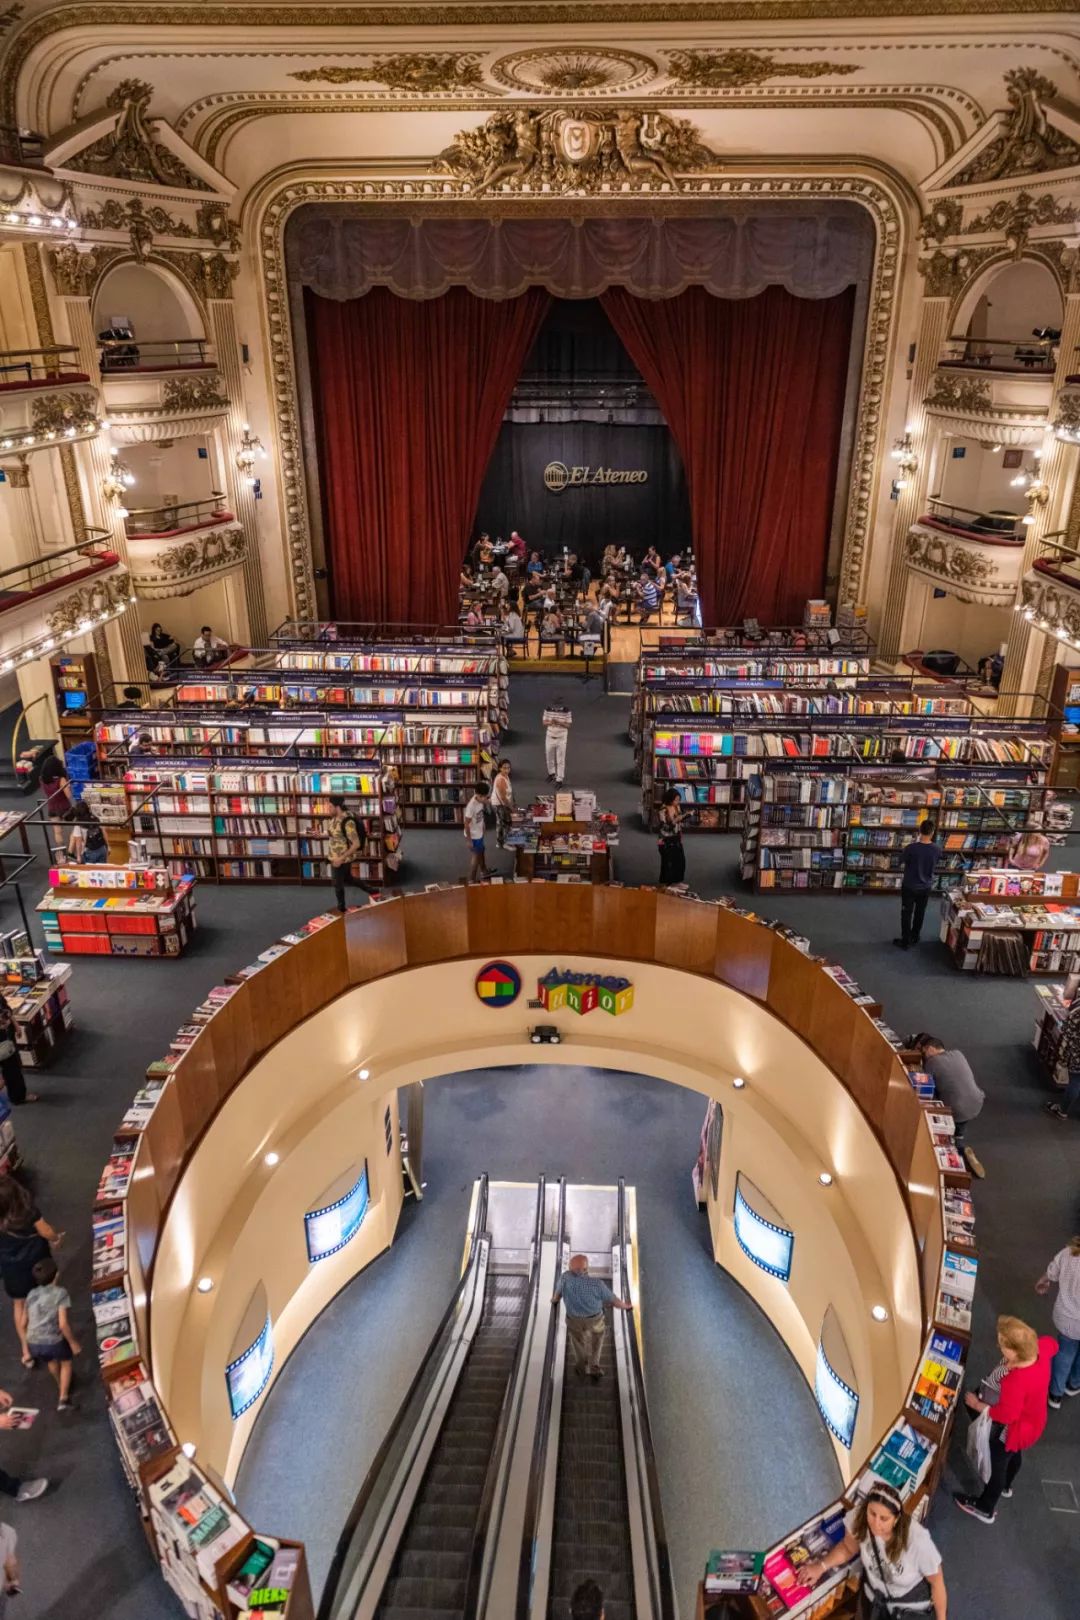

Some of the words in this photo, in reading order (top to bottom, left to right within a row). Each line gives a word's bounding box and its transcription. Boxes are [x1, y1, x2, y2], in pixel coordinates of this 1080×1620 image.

[568, 466, 590, 484] El
[591, 466, 648, 484] Ateneo
[539, 988, 633, 1010] Junior
